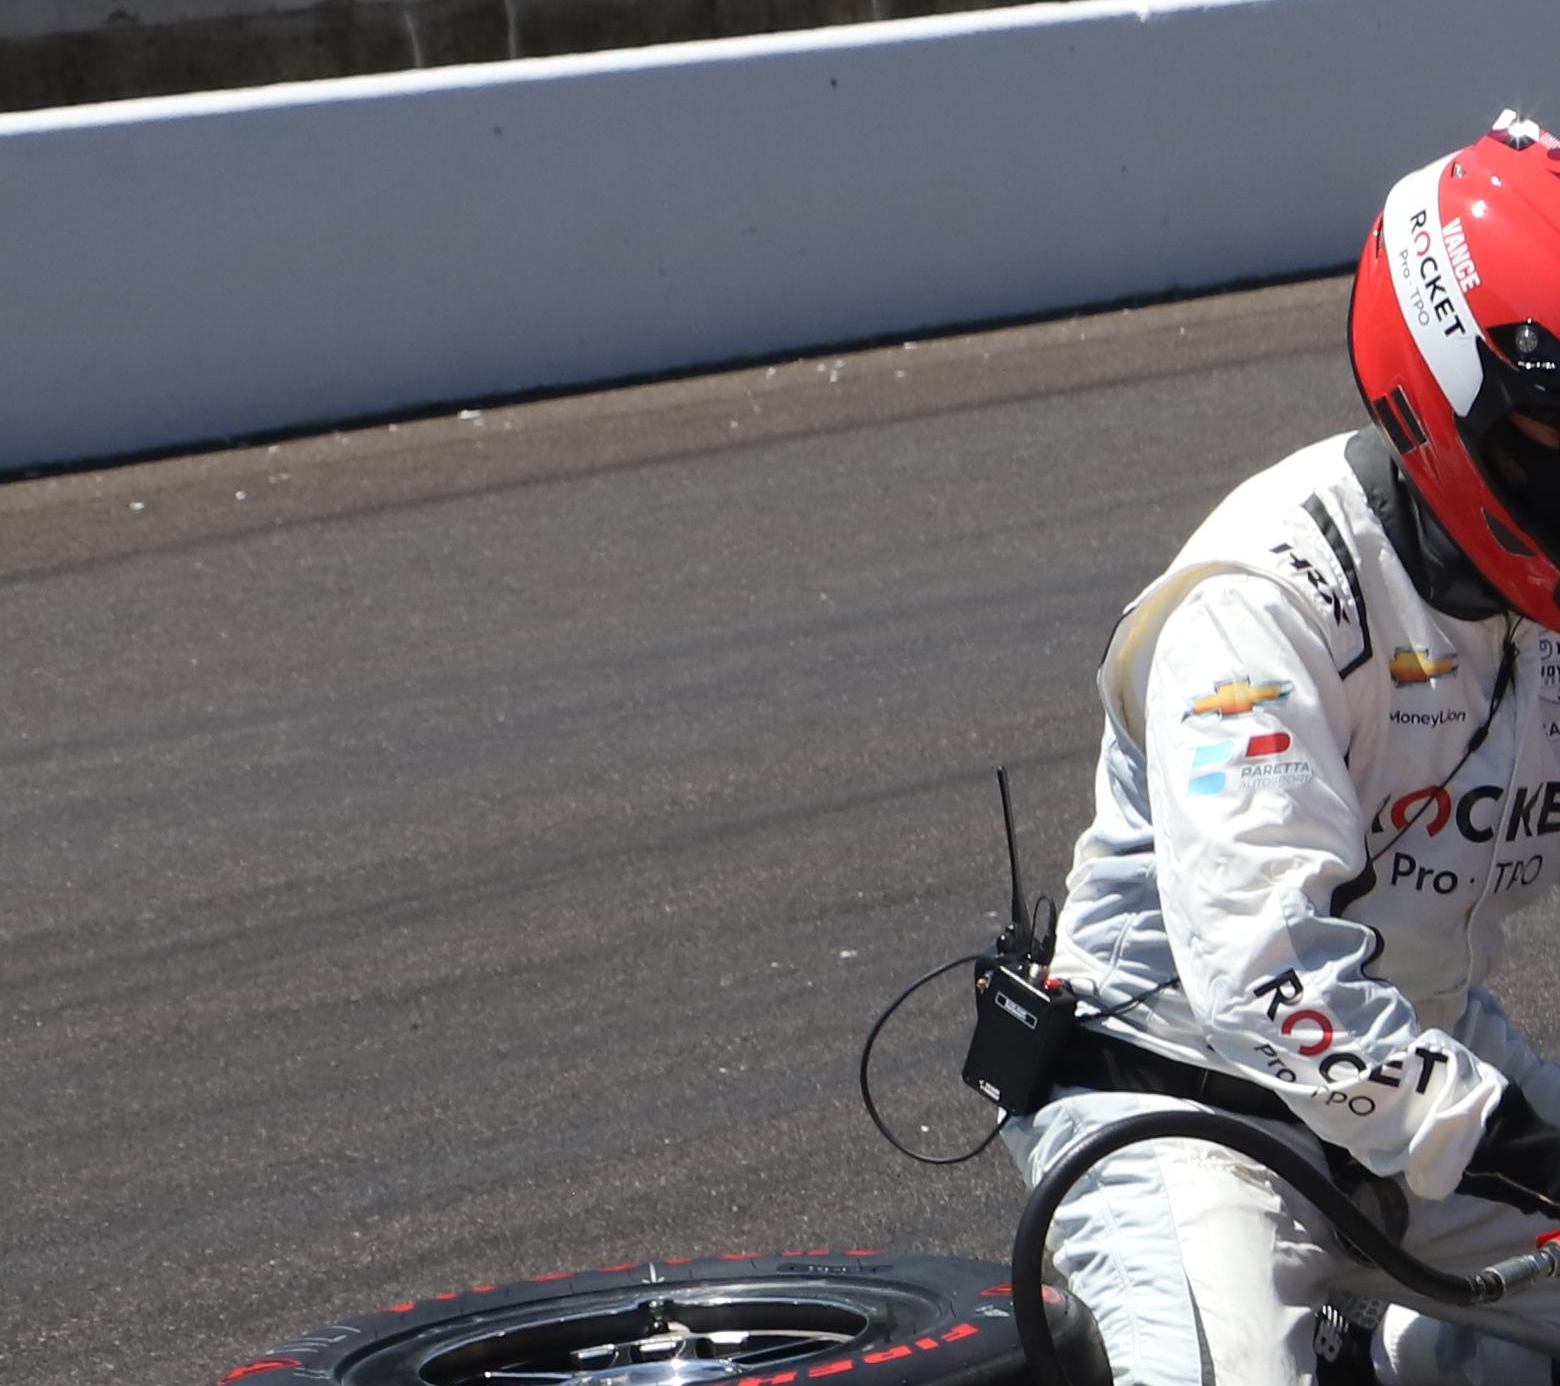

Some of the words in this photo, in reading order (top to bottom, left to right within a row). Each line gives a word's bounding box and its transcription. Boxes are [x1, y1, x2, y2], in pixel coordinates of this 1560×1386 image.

[1409, 208, 1466, 338] ROCKET
[1440, 218, 1482, 294] VANCE
[1398, 247, 1411, 275] Pro
[1408, 289, 1431, 329] TPO
[1388, 707, 1467, 728] MoneyLion
[1241, 760, 1310, 777] PARETTA
[1390, 851, 1459, 895] Pro
[1253, 967, 1450, 1095] ROCET
[1254, 1043, 1297, 1083] Pro
